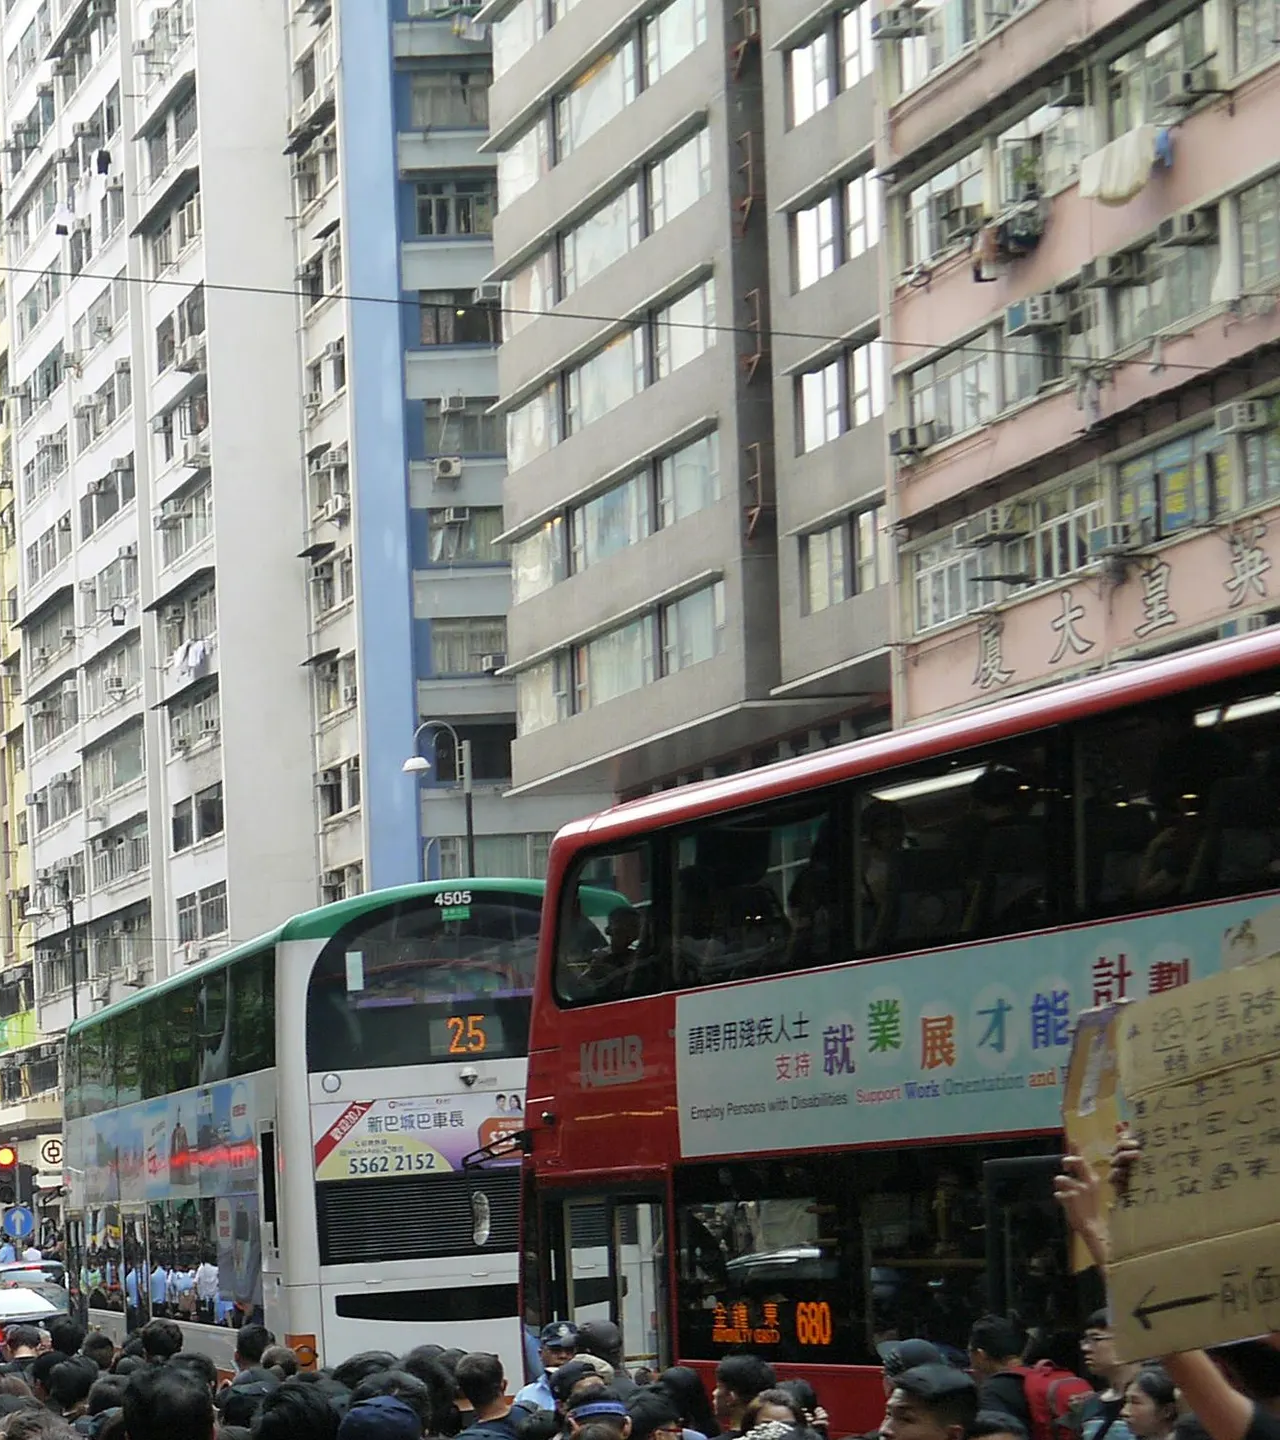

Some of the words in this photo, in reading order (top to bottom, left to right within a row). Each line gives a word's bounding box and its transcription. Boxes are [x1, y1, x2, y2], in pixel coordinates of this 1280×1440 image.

[434, 890, 472, 906] 4505
[446, 1014, 487, 1054] 25
[688, 1011, 810, 1055] 請聘用殘疾人士
[775, 1052, 811, 1081] 支持
[855, 1085, 903, 1104] Support
[905, 1081, 941, 1100] Work
[943, 1074, 1025, 1098] Orientation
[1028, 1069, 1057, 1088] and
[690, 1106, 725, 1121] Employ
[726, 1101, 766, 1116] Persons
[768, 1096, 789, 1112] with
[791, 1091, 848, 1109] Disabilities
[367, 1110, 465, 1133] 新巴城巴車長
[349, 1156, 389, 1174] 5562
[395, 1153, 435, 1171] 2152
[797, 1301, 832, 1344] 680
